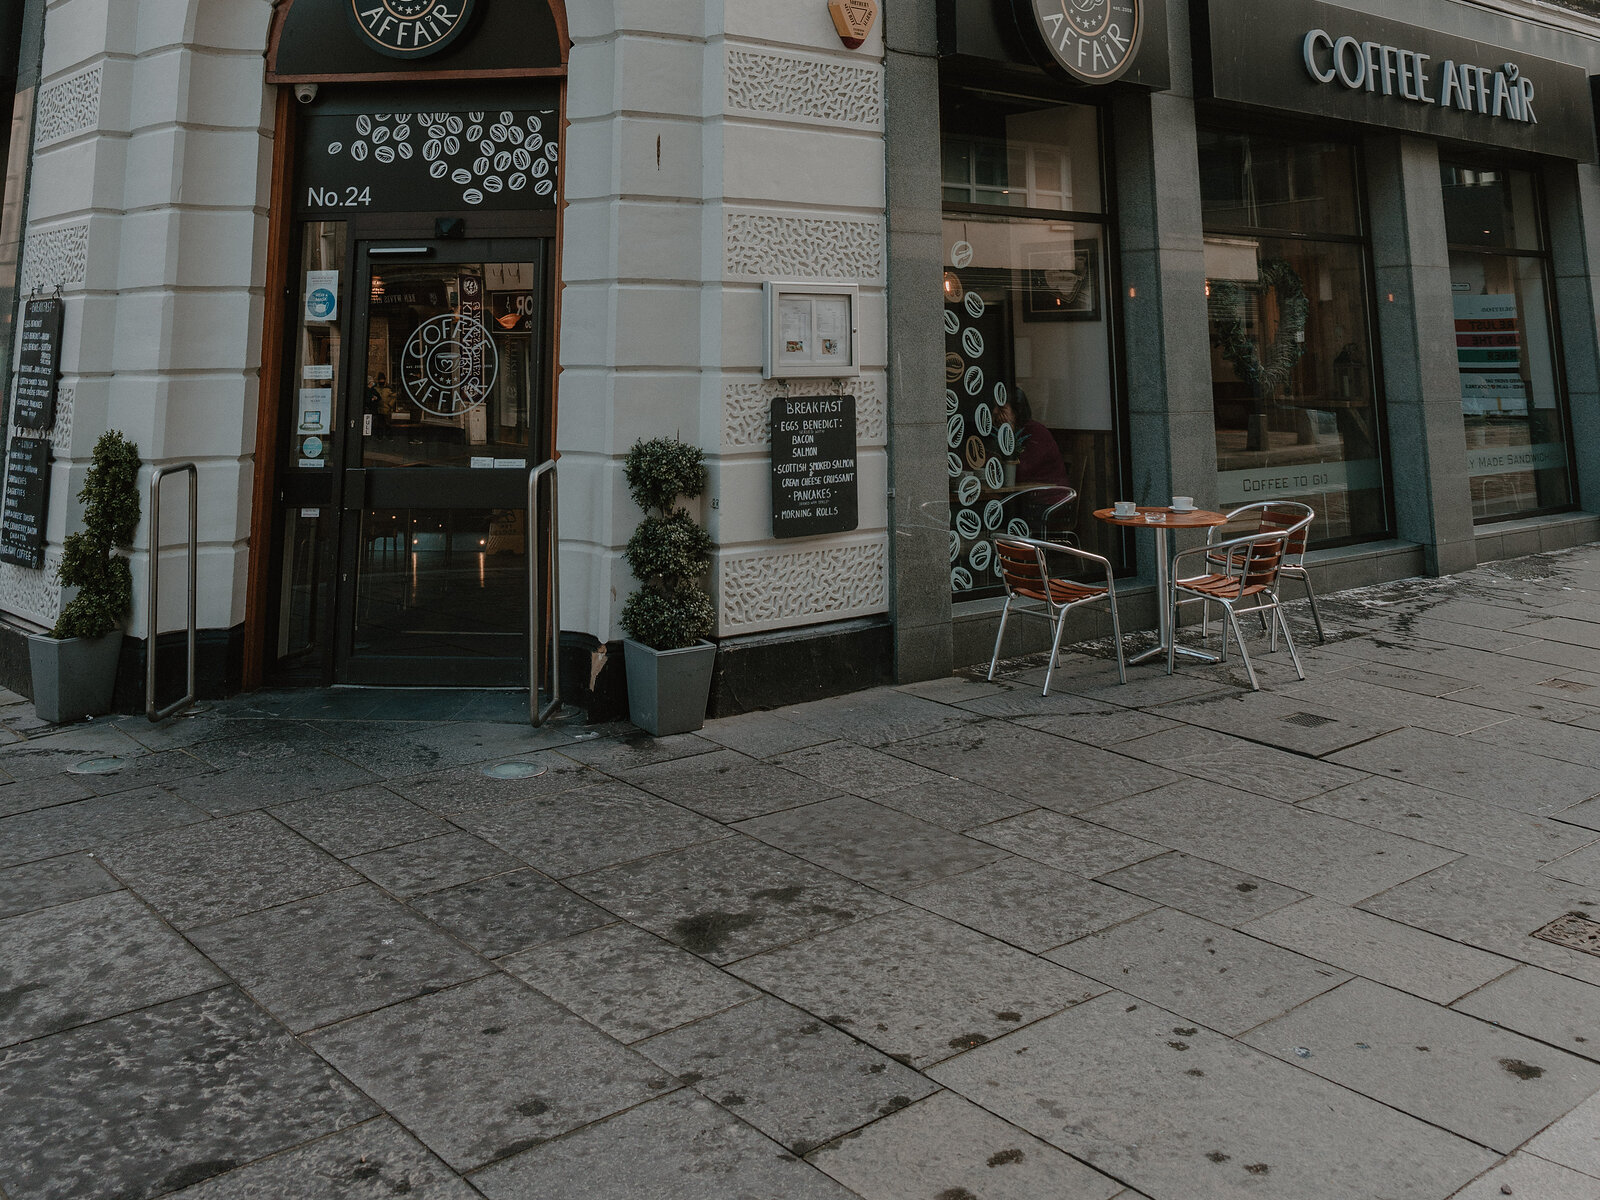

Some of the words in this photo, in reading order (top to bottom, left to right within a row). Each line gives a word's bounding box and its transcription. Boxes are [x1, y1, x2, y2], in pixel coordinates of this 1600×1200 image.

[1303, 29, 1435, 104] COFFEE
[307, 186, 371, 207] No.24
[409, 318, 491, 358] COFFEE
[786, 400, 843, 414] BREAKFAST
[780, 421, 799, 432] EGGS
[792, 435, 814, 445] BACON
[792, 447, 818, 457] SALMON
[777, 463, 807, 474] SCOTTISH
[808, 460, 832, 471] SMOKED
[832, 459, 854, 469] SALMON
[1479, 457, 1504, 468] MADE
[1507, 452, 1560, 465] SANDWICH
[782, 478, 800, 488] CREAM
[801, 476, 822, 486] CHEESE
[823, 473, 854, 484] CROISSANT
[1243, 477, 1288, 491] COFFEE
[1293, 475, 1308, 487] TO
[793, 488, 832, 501] PANCAKES
[781, 508, 812, 520] MORNING
[816, 507, 838, 517] ROLLS
